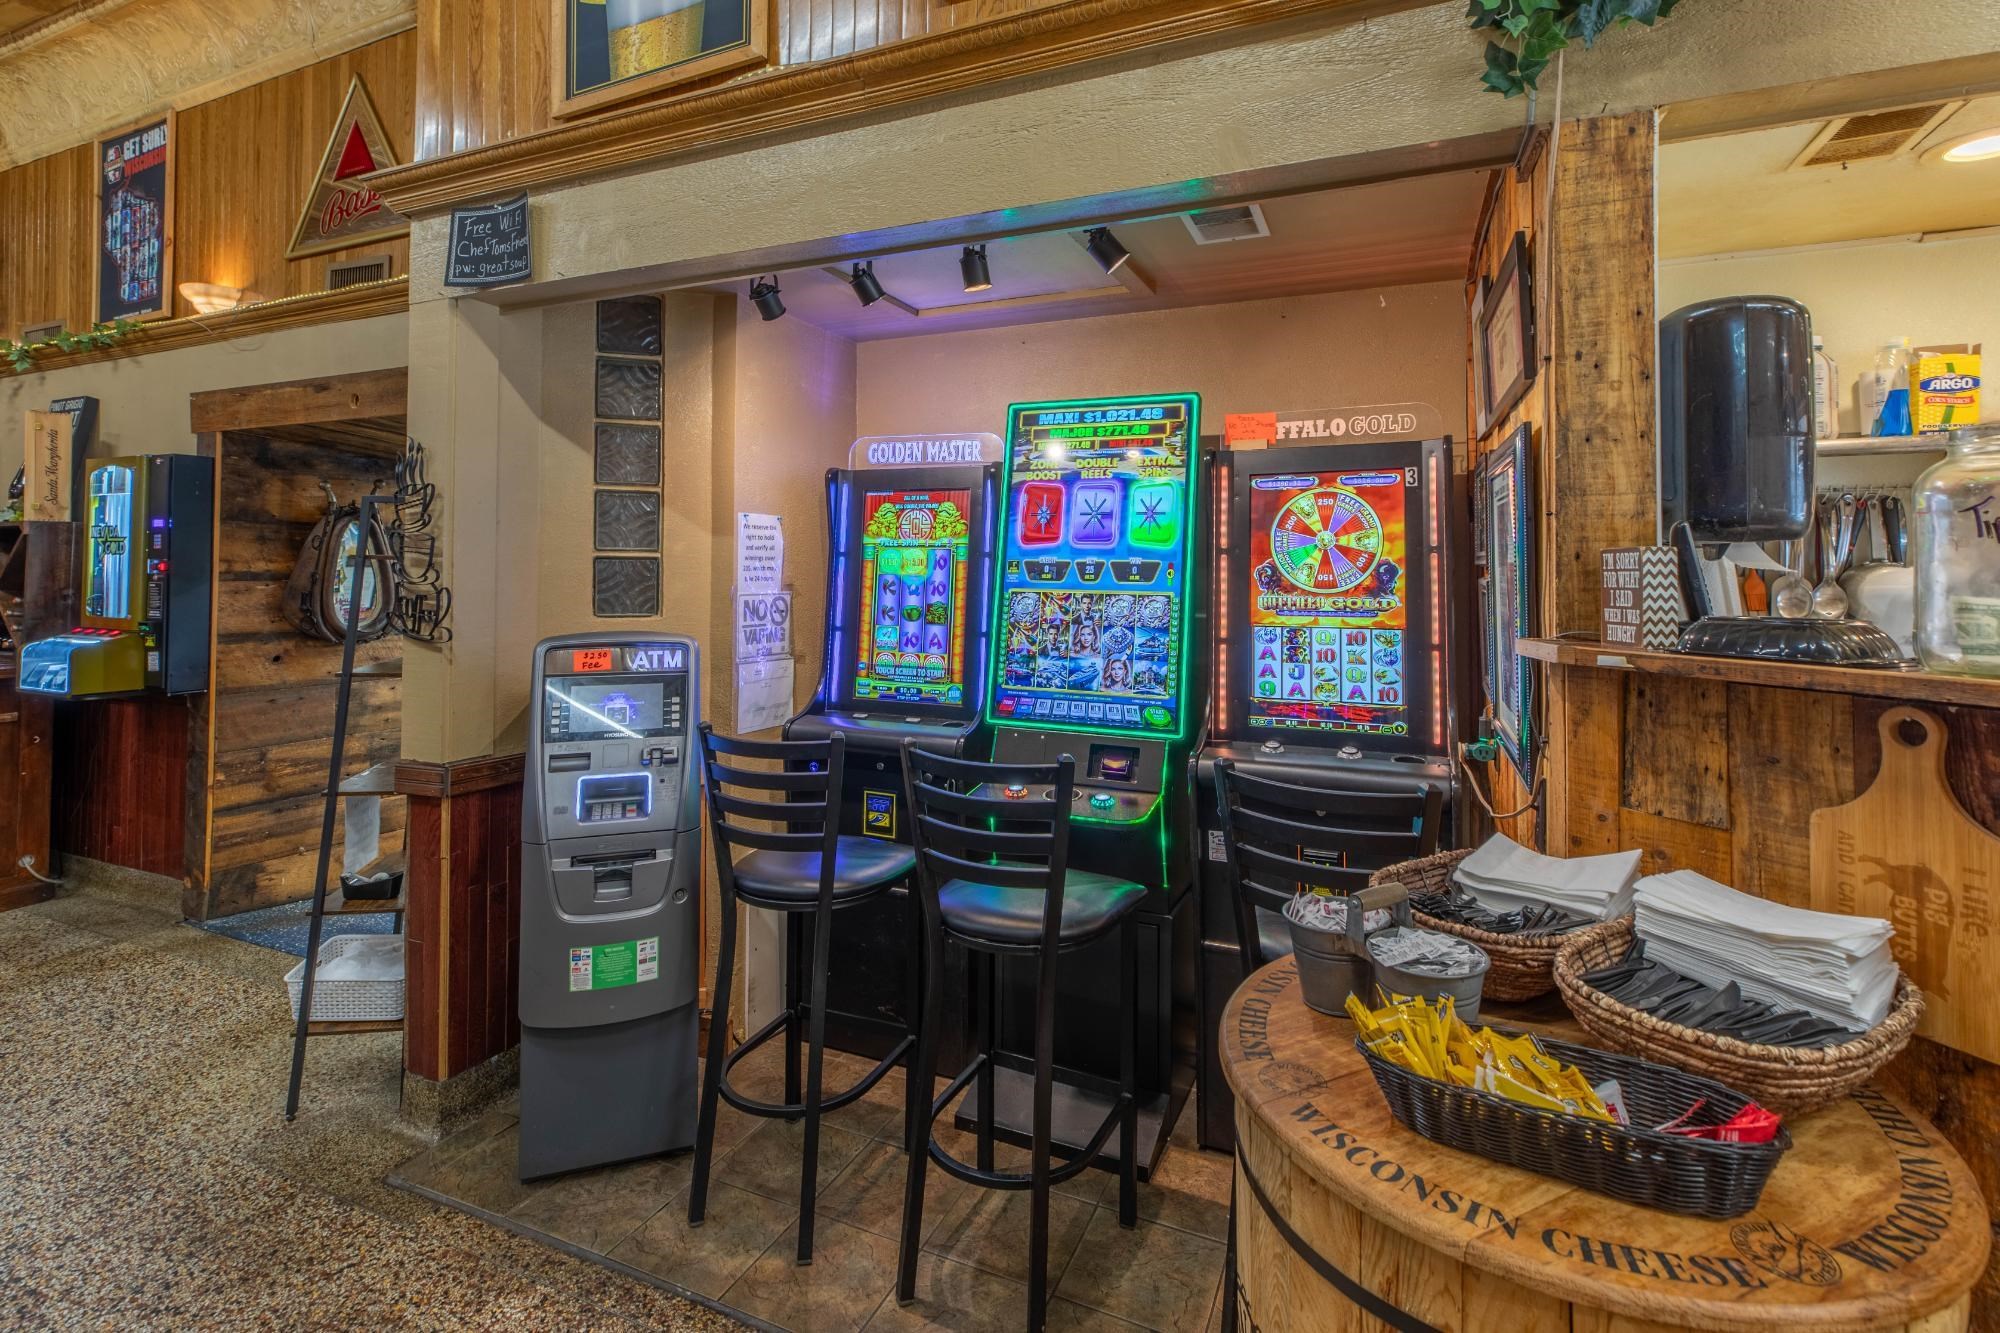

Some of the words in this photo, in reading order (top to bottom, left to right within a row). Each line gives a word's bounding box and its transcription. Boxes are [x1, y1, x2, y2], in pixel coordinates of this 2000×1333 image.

[124, 136, 140, 160] GET
[464, 217, 492, 237] Free
[455, 264, 475, 277] pw:
[1928, 377, 1973, 391] ARGO
[1039, 412, 1080, 425] MAXI
[1084, 407, 1164, 424] $1,021.48
[1048, 426, 1094, 438] MAJOR
[1276, 418, 1346, 439] FFALO
[1349, 413, 1416, 435] GOLD
[868, 441, 923, 464] GOLDEN
[925, 440, 984, 462] MASTER
[1075, 457, 1120, 469] DOUBLE
[1137, 456, 1176, 467] EXTRA
[1025, 471, 1062, 481] BOOST
[1081, 468, 1113, 479] REELS
[1138, 468, 1173, 478] SPINS
[1407, 468, 1416, 485] 3
[43, 479, 58, 506] Santa
[1339, 495, 1360, 509] FREE
[1285, 515, 1297, 529] 200
[104, 540, 126, 556] GOLD
[1356, 553, 1369, 567] 100
[1602, 553, 1614, 569] I'M
[1616, 552, 1639, 569] SORRY
[1085, 565, 1094, 574] 25
[1603, 571, 1617, 588] FOR
[1617, 571, 1640, 588] WHAT
[1327, 597, 1399, 612] GOLD
[1610, 590, 1614, 606] I
[1615, 590, 1633, 607] SAID
[743, 599, 768, 621] NO
[1604, 608, 1621, 622] WHEN
[1622, 608, 1626, 623] I
[1626, 609, 1640, 624] WAS
[743, 626, 785, 645] VAPING
[1315, 629, 1336, 646] Q
[1346, 631, 1367, 647] 10
[1607, 624, 1636, 643] HUNGRY
[632, 650, 682, 669] ATM
[1259, 646, 1277, 661] A
[1316, 648, 1337, 664] 10
[1347, 649, 1367, 665] K
[582, 661, 604, 670] Fee
[1258, 663, 1277, 678] A
[1288, 664, 1305, 680] J
[1259, 680, 1276, 697] 9
[1287, 682, 1306, 697] A
[1347, 685, 1367, 700] A
[1377, 687, 1399, 703] 10
[1894, 894, 1917, 962] BUTTS
[1239, 998, 1275, 1061] CHEESE
[1851, 1084, 1931, 1148] CHEE
[1290, 1102, 1520, 1240] WISCONSIN
[1541, 1228, 1769, 1289] CHEESE
[1831, 1150, 1952, 1272] WISCONSIN
